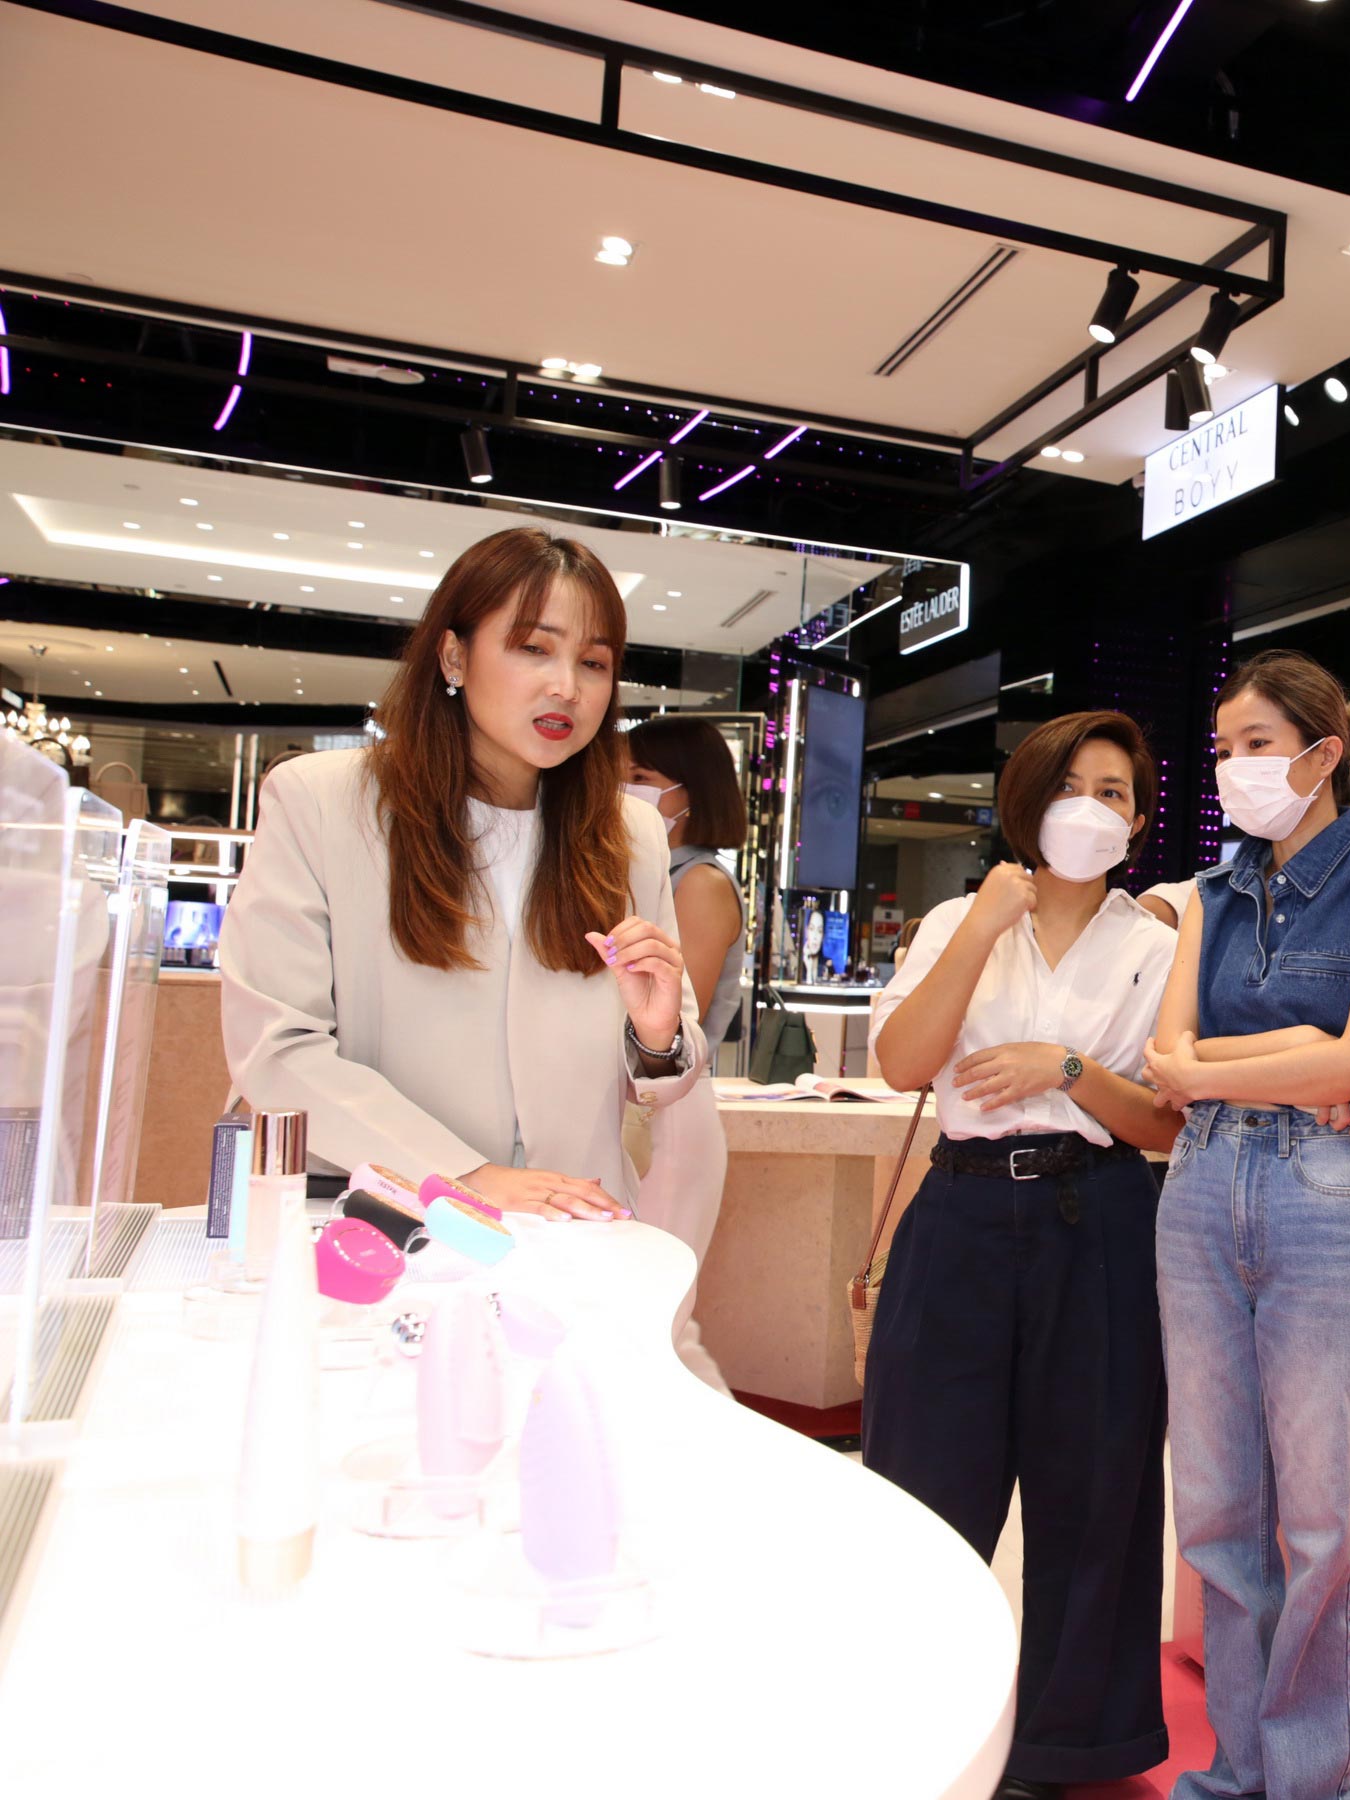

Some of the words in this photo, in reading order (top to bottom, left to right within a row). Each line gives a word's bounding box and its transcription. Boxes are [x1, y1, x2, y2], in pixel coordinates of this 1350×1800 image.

[1169, 410, 1248, 471] CENTRAL
[1174, 461, 1239, 516] BOYY
[924, 586, 959, 623] LAUDER
